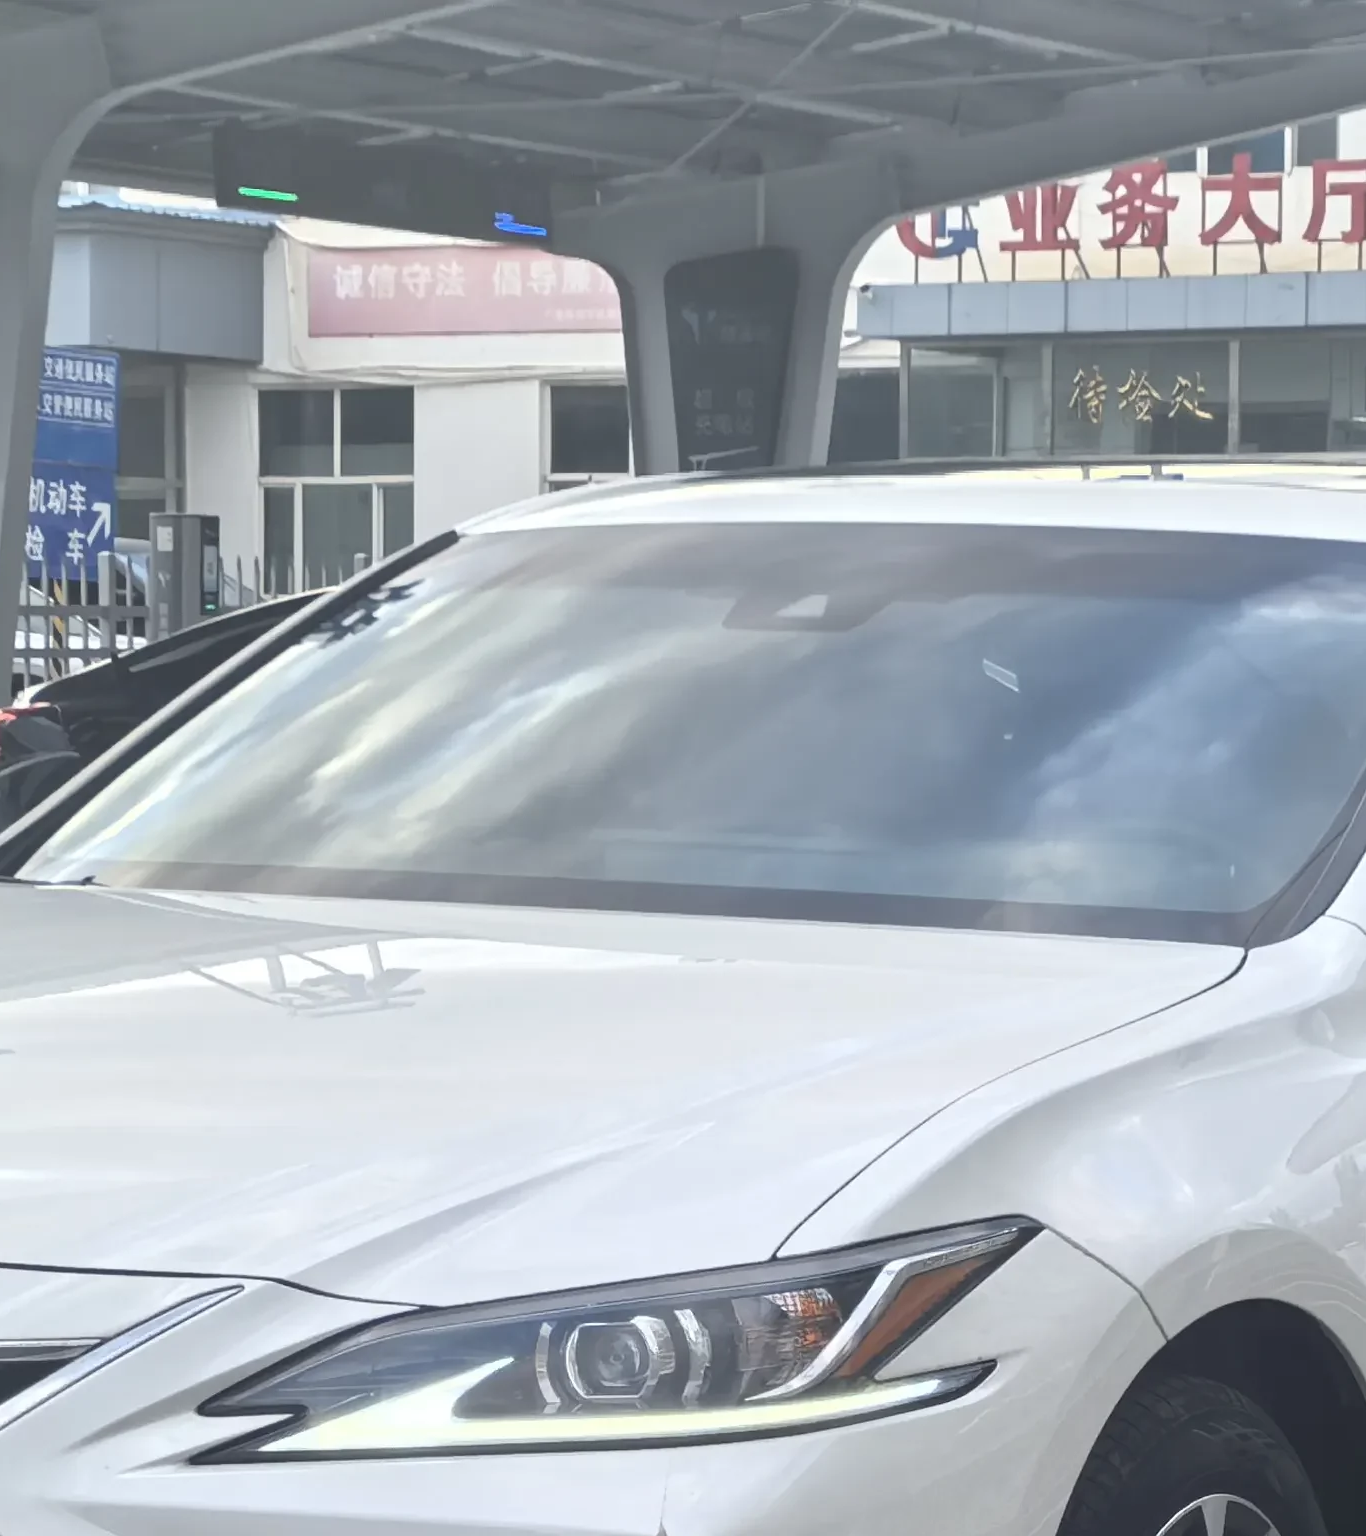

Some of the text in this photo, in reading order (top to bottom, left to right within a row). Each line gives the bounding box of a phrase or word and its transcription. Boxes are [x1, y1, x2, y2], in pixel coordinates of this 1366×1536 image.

[332, 259, 619, 300] 诚信守法 倡导廉
[1067, 364, 1214, 424] 待检处
[28, 475, 87, 518] 机动车
